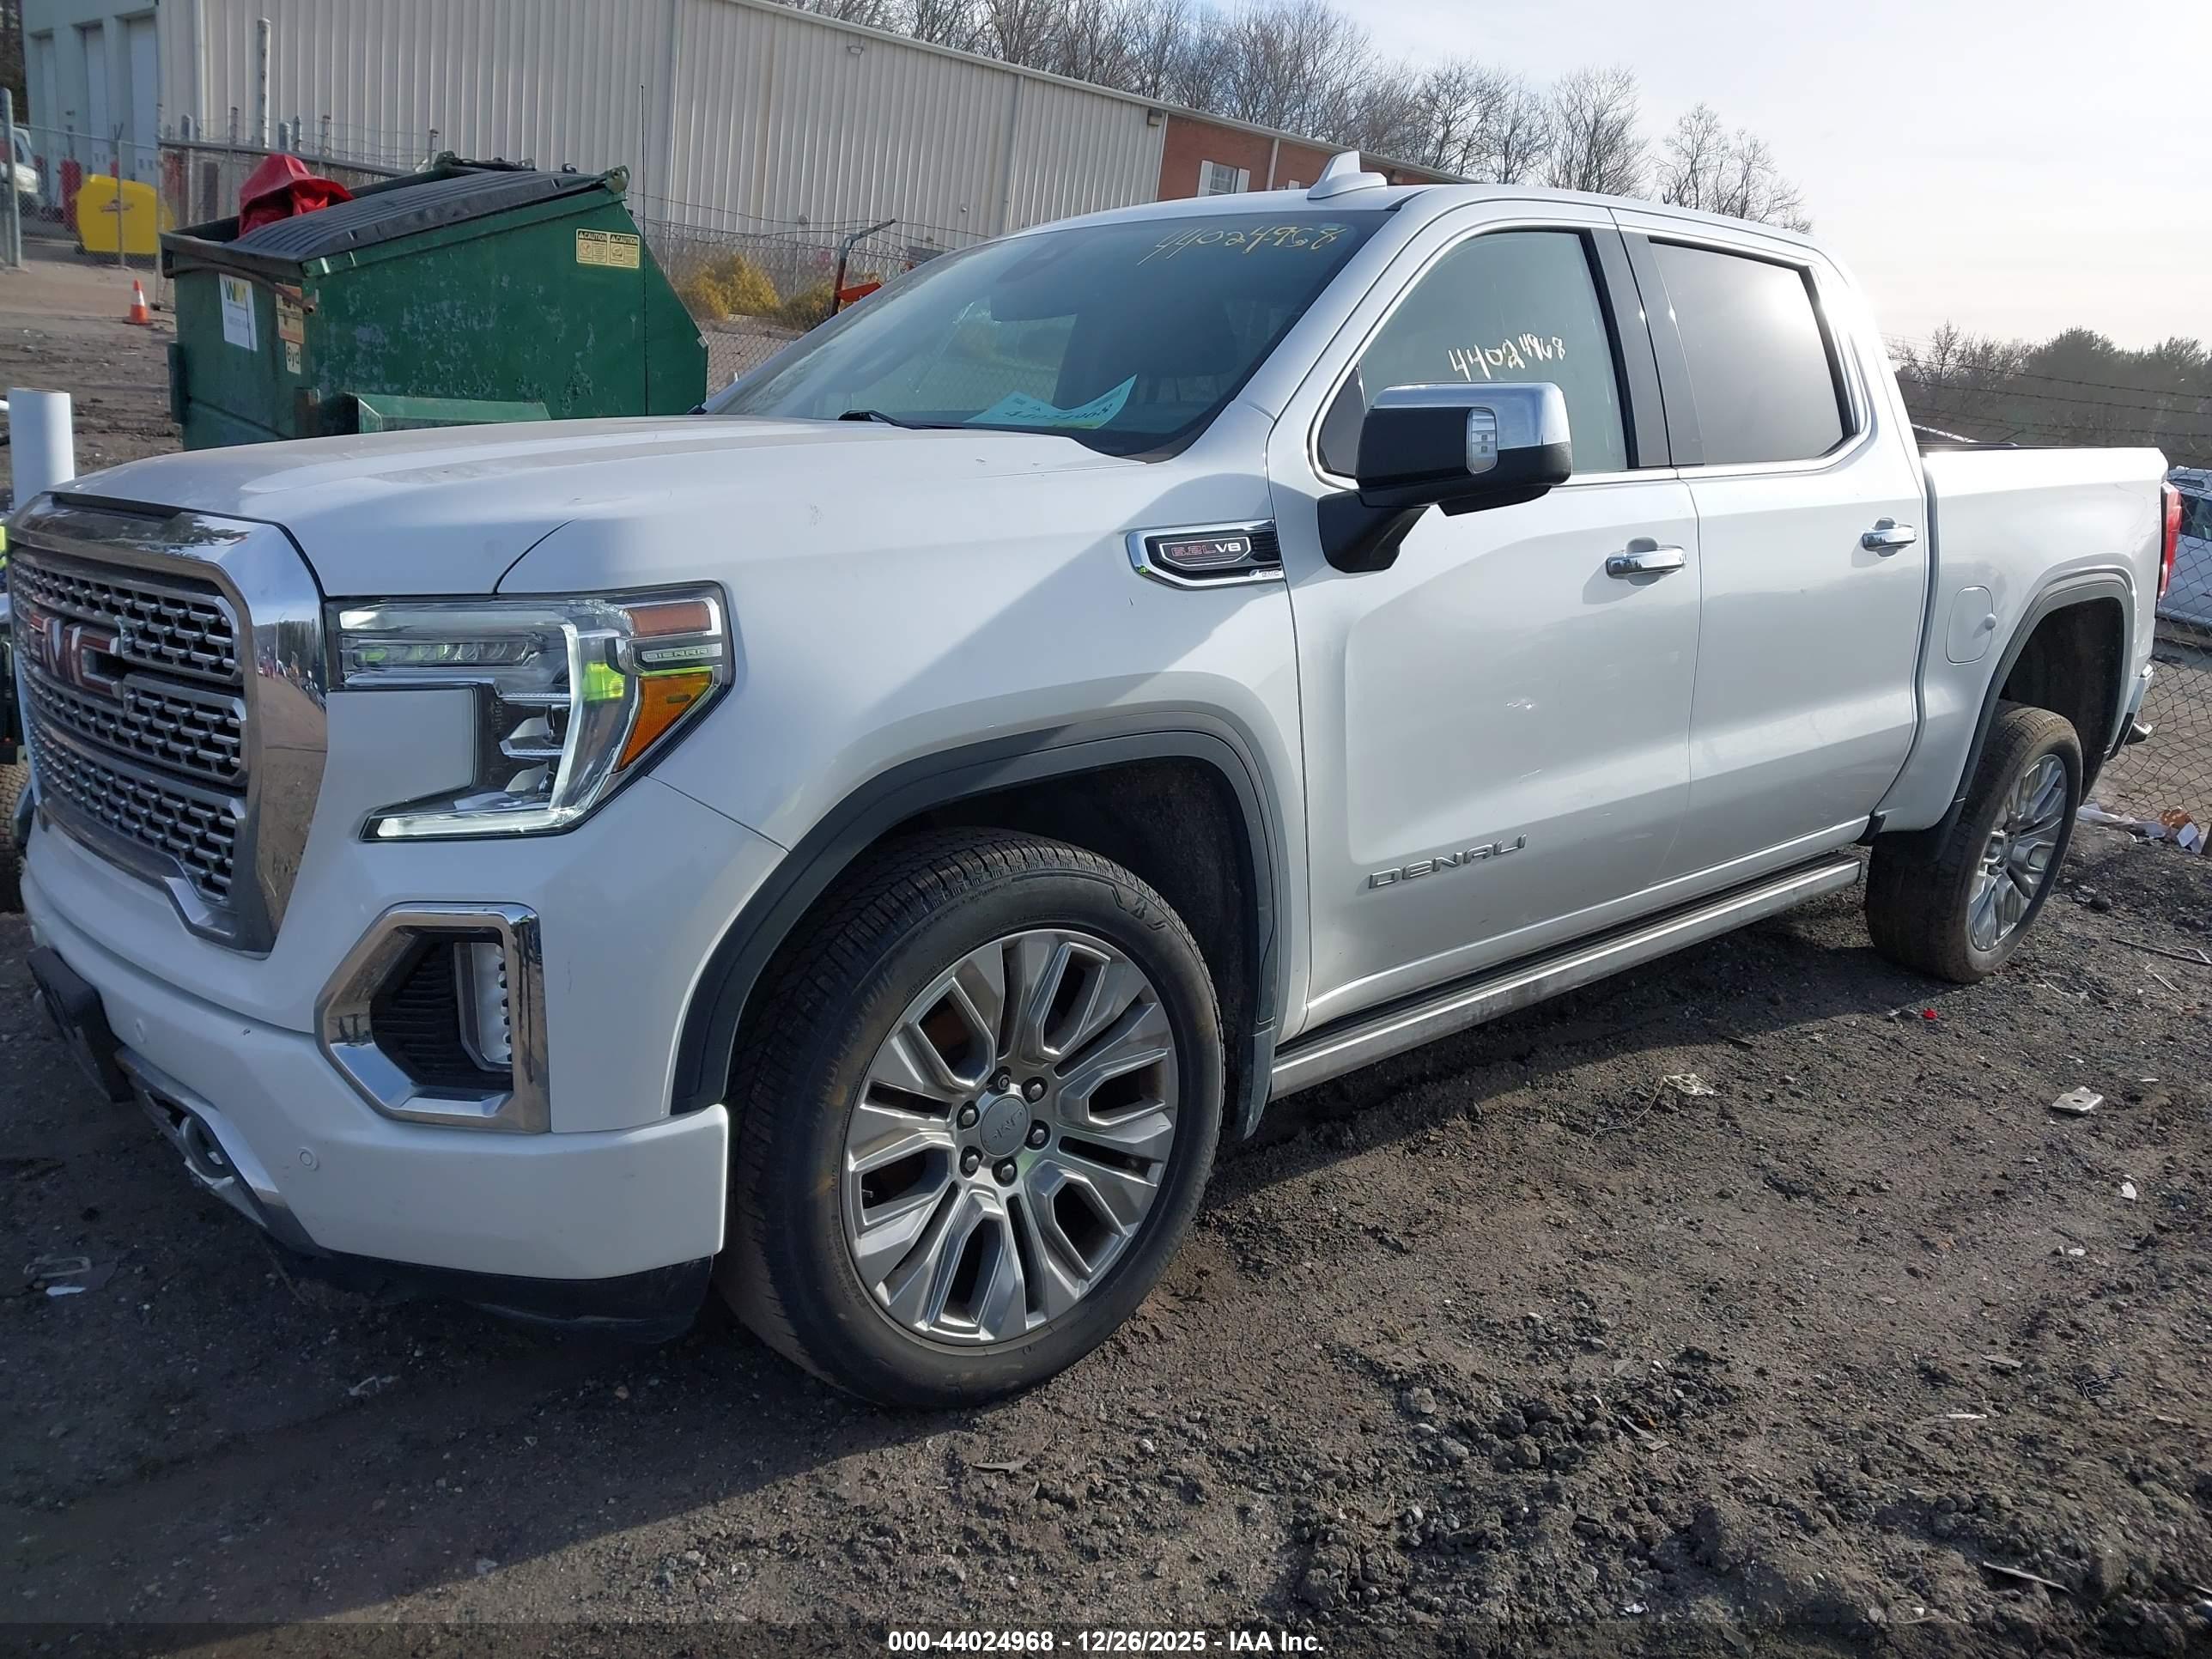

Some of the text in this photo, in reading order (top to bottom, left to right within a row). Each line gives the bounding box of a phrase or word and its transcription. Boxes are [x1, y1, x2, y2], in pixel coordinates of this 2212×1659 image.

[584, 232, 607, 241] CAUTION
[616, 236, 638, 245] CAUTION
[1137, 226, 1347, 266] 44024968
[1448, 333, 1566, 382] 44024968
[645, 647, 708, 659] SIERRA
[1369, 833, 1528, 890] DENALI
